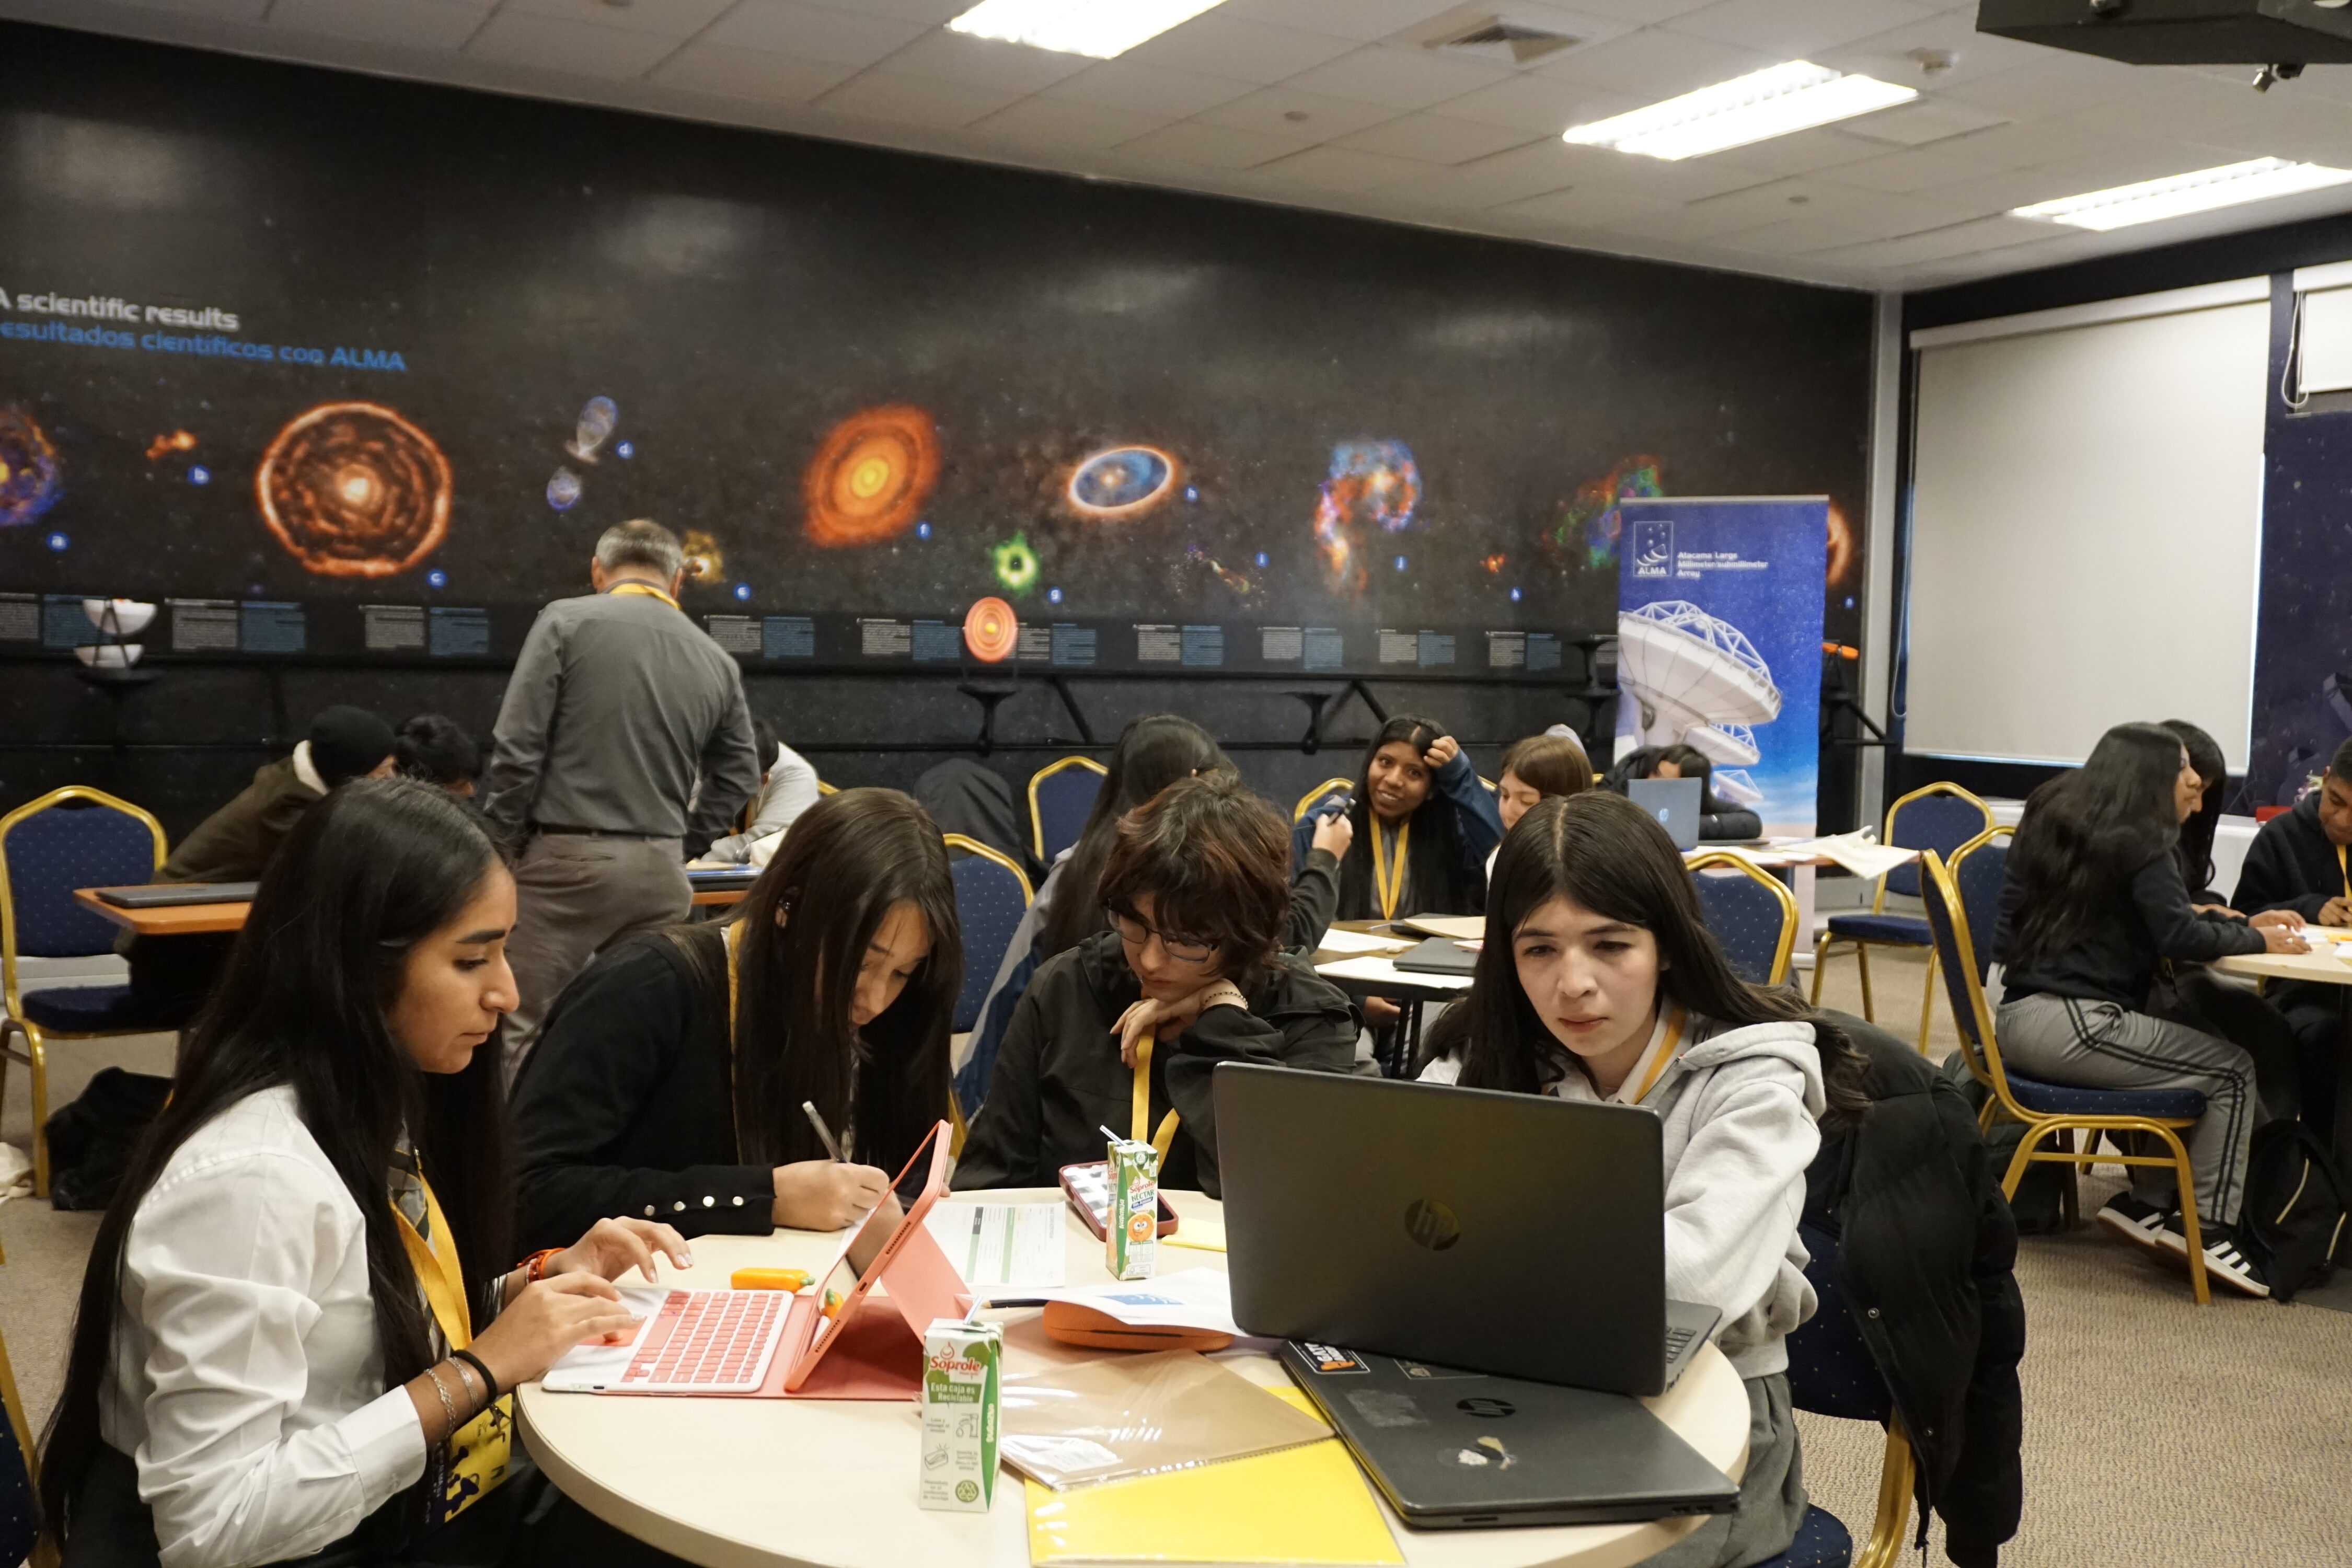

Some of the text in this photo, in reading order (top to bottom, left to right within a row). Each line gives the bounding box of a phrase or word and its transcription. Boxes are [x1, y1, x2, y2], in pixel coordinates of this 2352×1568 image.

[17, 292, 140, 323] scientific
[145, 305, 240, 332] results
[0, 320, 135, 350] esultados
[279, 345, 325, 364] con
[329, 345, 407, 372] ALMA
[1715, 551, 1738, 560] Large
[1637, 567, 1667, 575] ALMA
[1677, 569, 1701, 579] Array
[1129, 1180, 1155, 1194] Soprole
[930, 1356, 981, 1373] Soprole
[931, 1382, 975, 1395] Esta caja es
[938, 1392, 974, 1403] Reciclable
